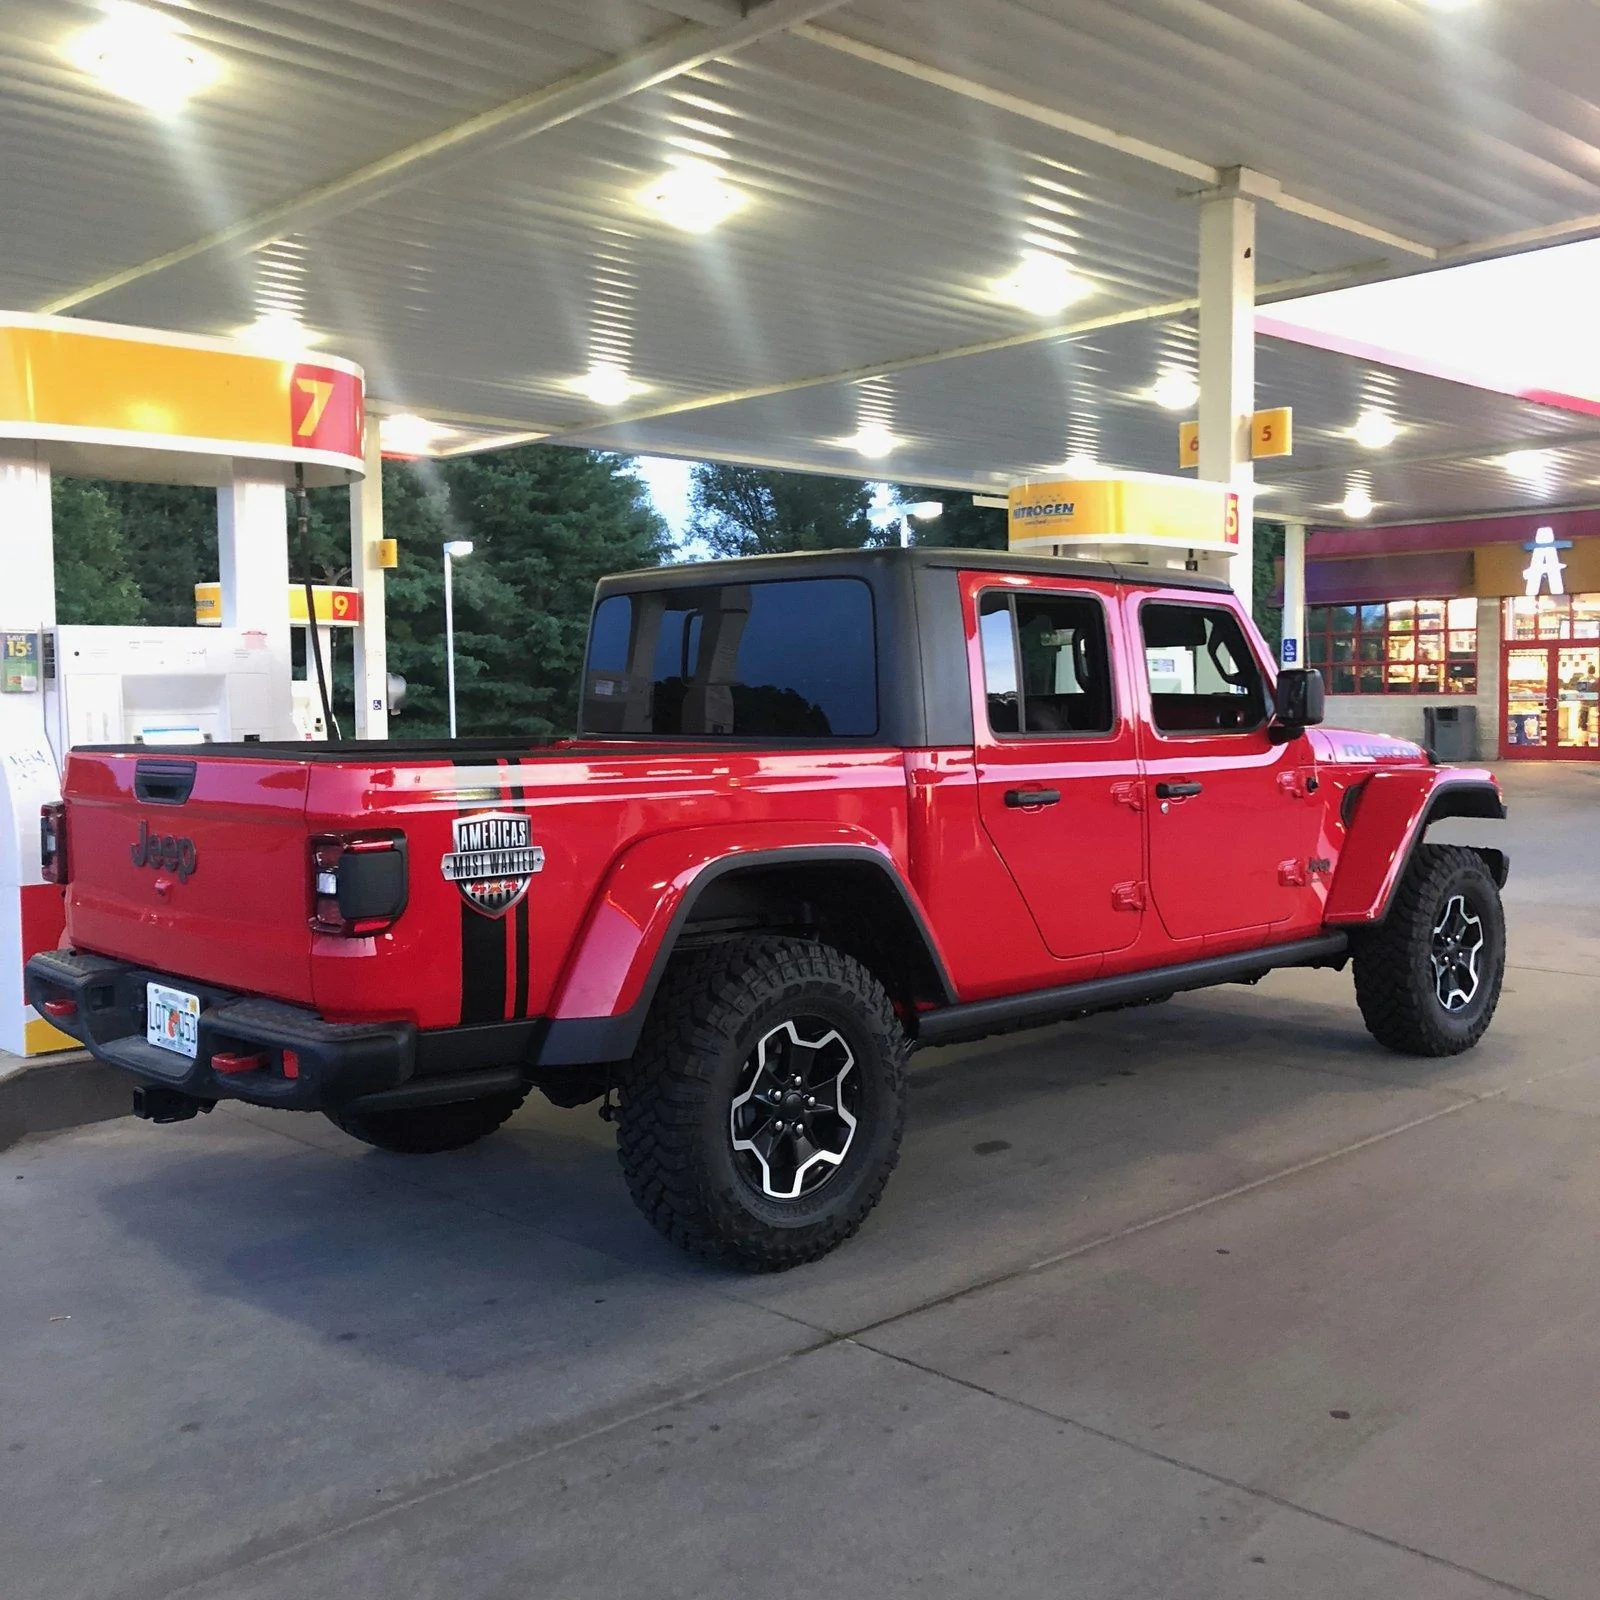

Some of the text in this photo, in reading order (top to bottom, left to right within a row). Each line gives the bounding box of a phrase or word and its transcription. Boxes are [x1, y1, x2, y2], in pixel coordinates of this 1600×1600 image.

[296, 378, 335, 436] 7
[1262, 424, 1272, 442] 5
[1226, 499, 1237, 535] 5
[334, 595, 349, 617] 9
[460, 820, 526, 851] AMERICAS
[130, 820, 196, 884] Jeep
[453, 850, 534, 878] MOST WANTED
